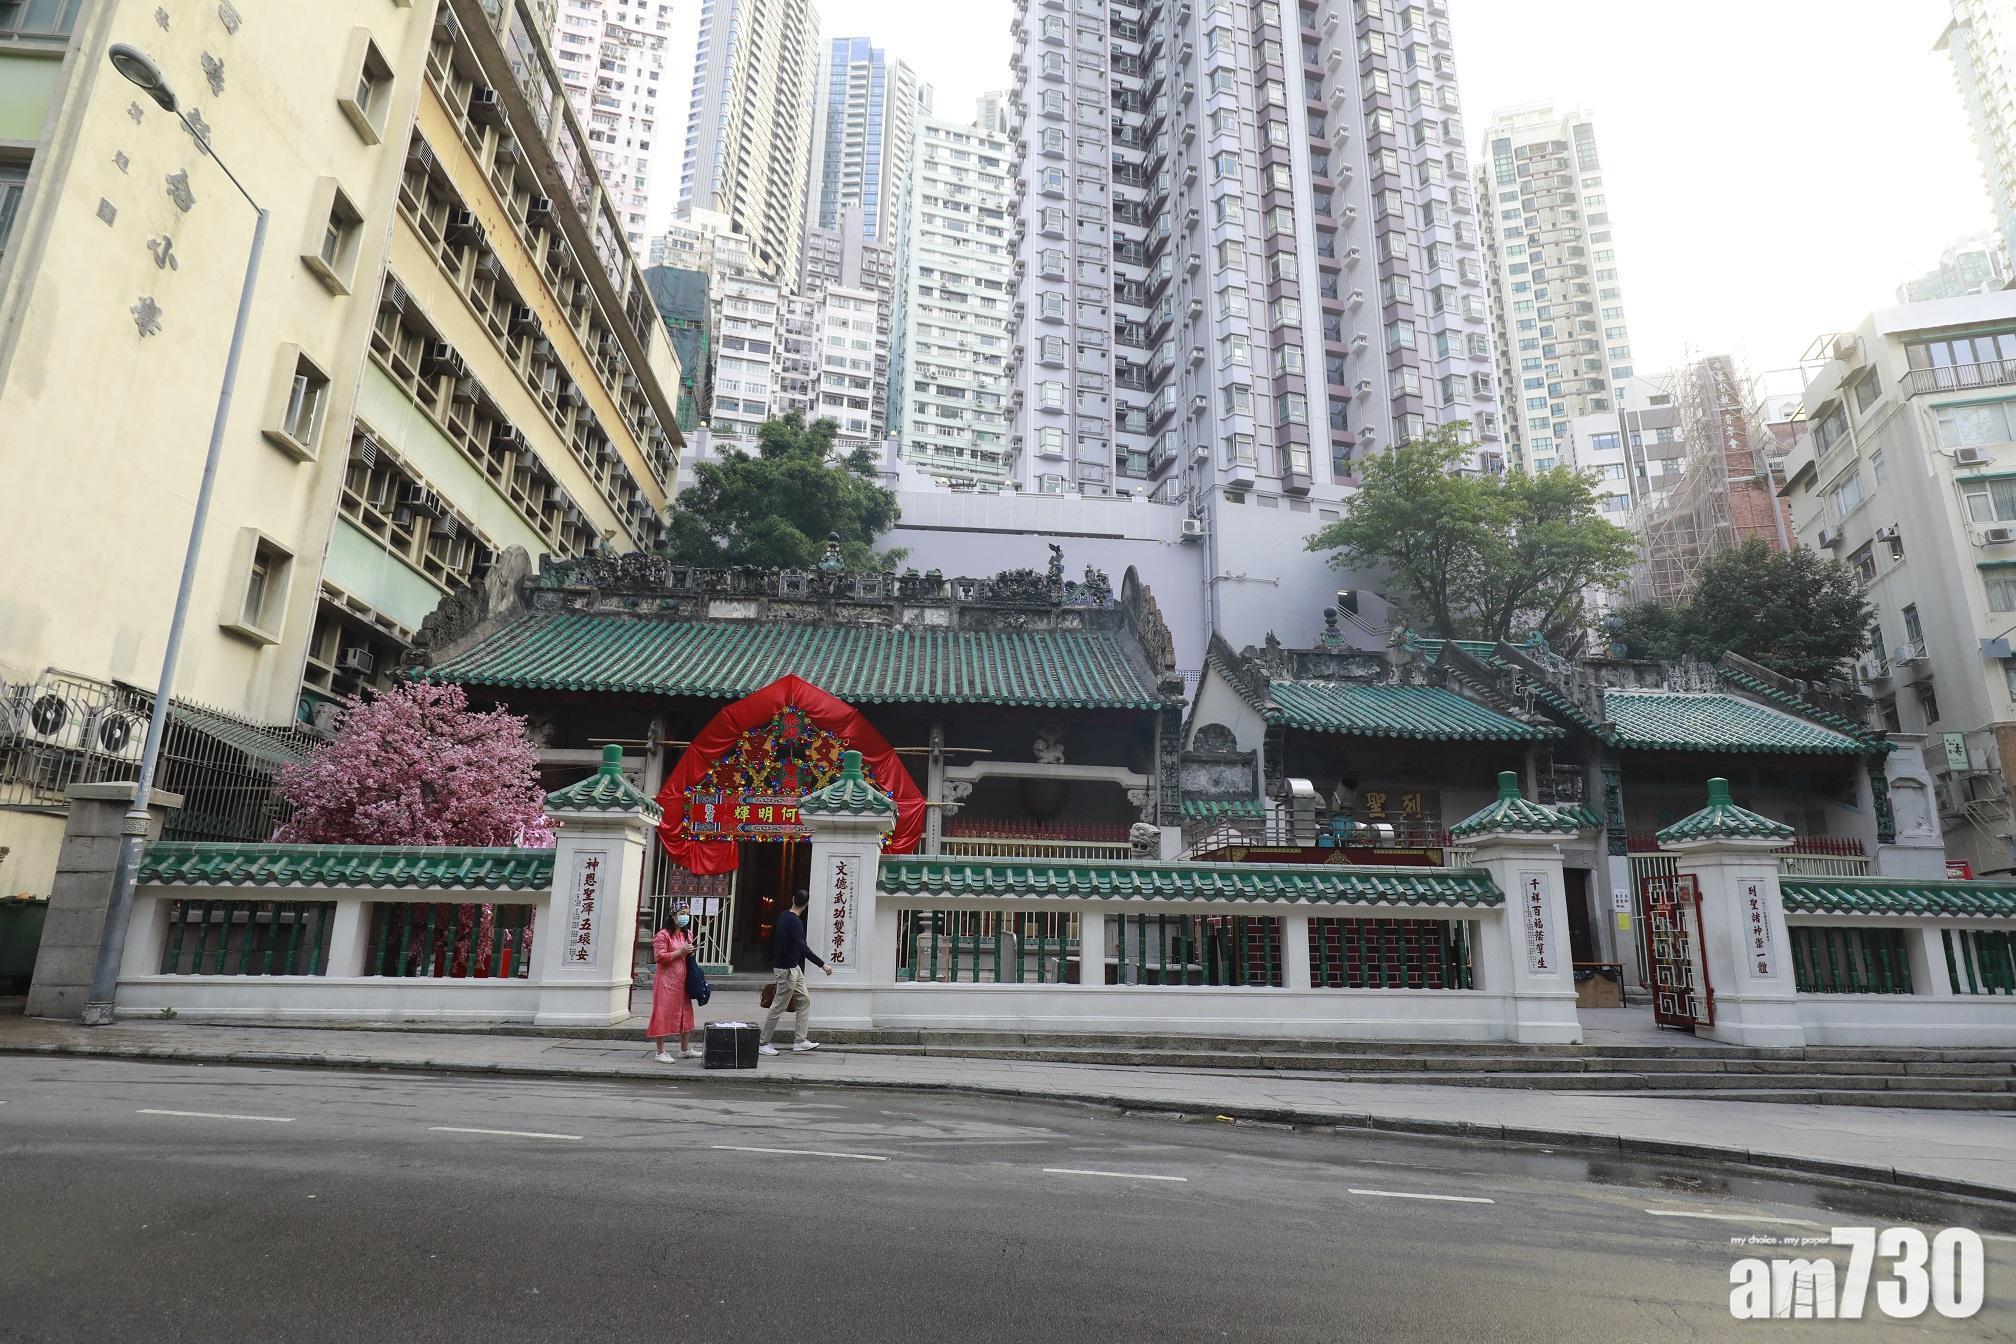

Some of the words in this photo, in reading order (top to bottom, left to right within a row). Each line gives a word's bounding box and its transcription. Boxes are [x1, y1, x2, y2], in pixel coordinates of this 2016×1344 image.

[830, 861, 848, 963] 文德武功雙帝祀
